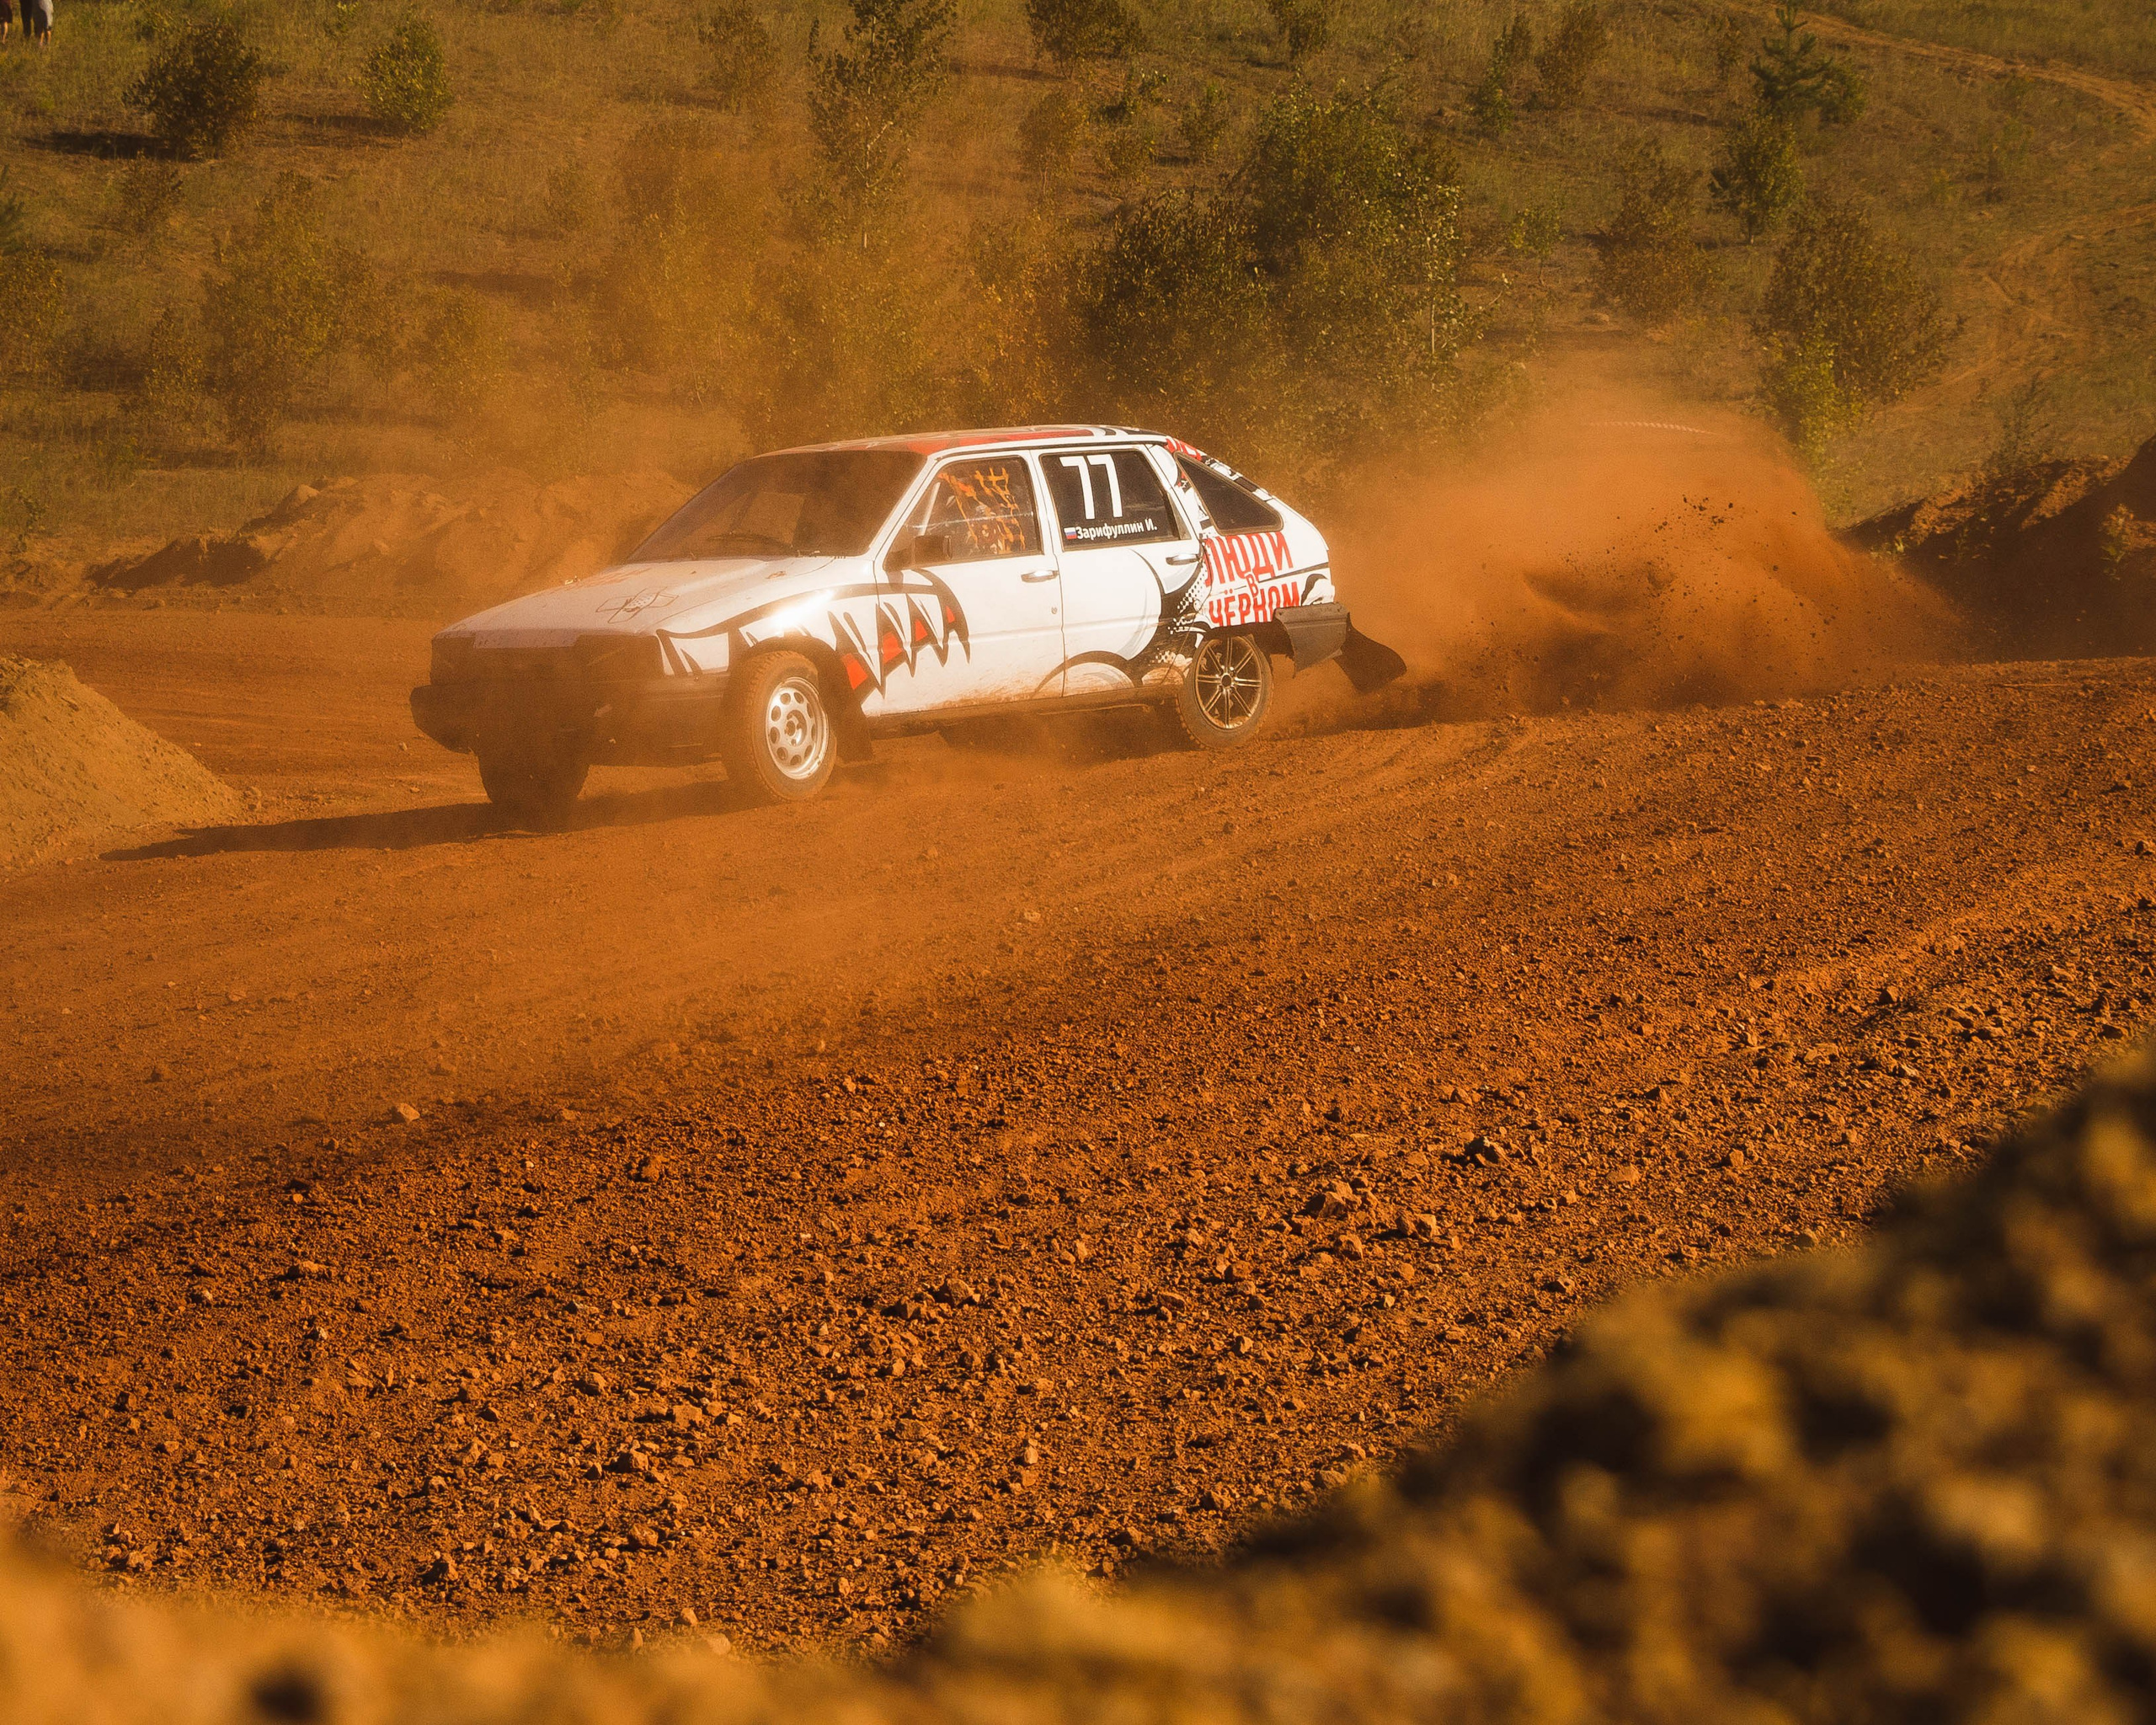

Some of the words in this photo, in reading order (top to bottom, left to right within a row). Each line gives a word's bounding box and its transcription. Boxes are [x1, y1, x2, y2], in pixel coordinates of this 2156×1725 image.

[1059, 454, 1123, 520] 77
[1075, 522, 1145, 540] Зарифуллин
[1145, 518, 1158, 531] И.
[1203, 531, 1294, 587] ЛЮДИ
